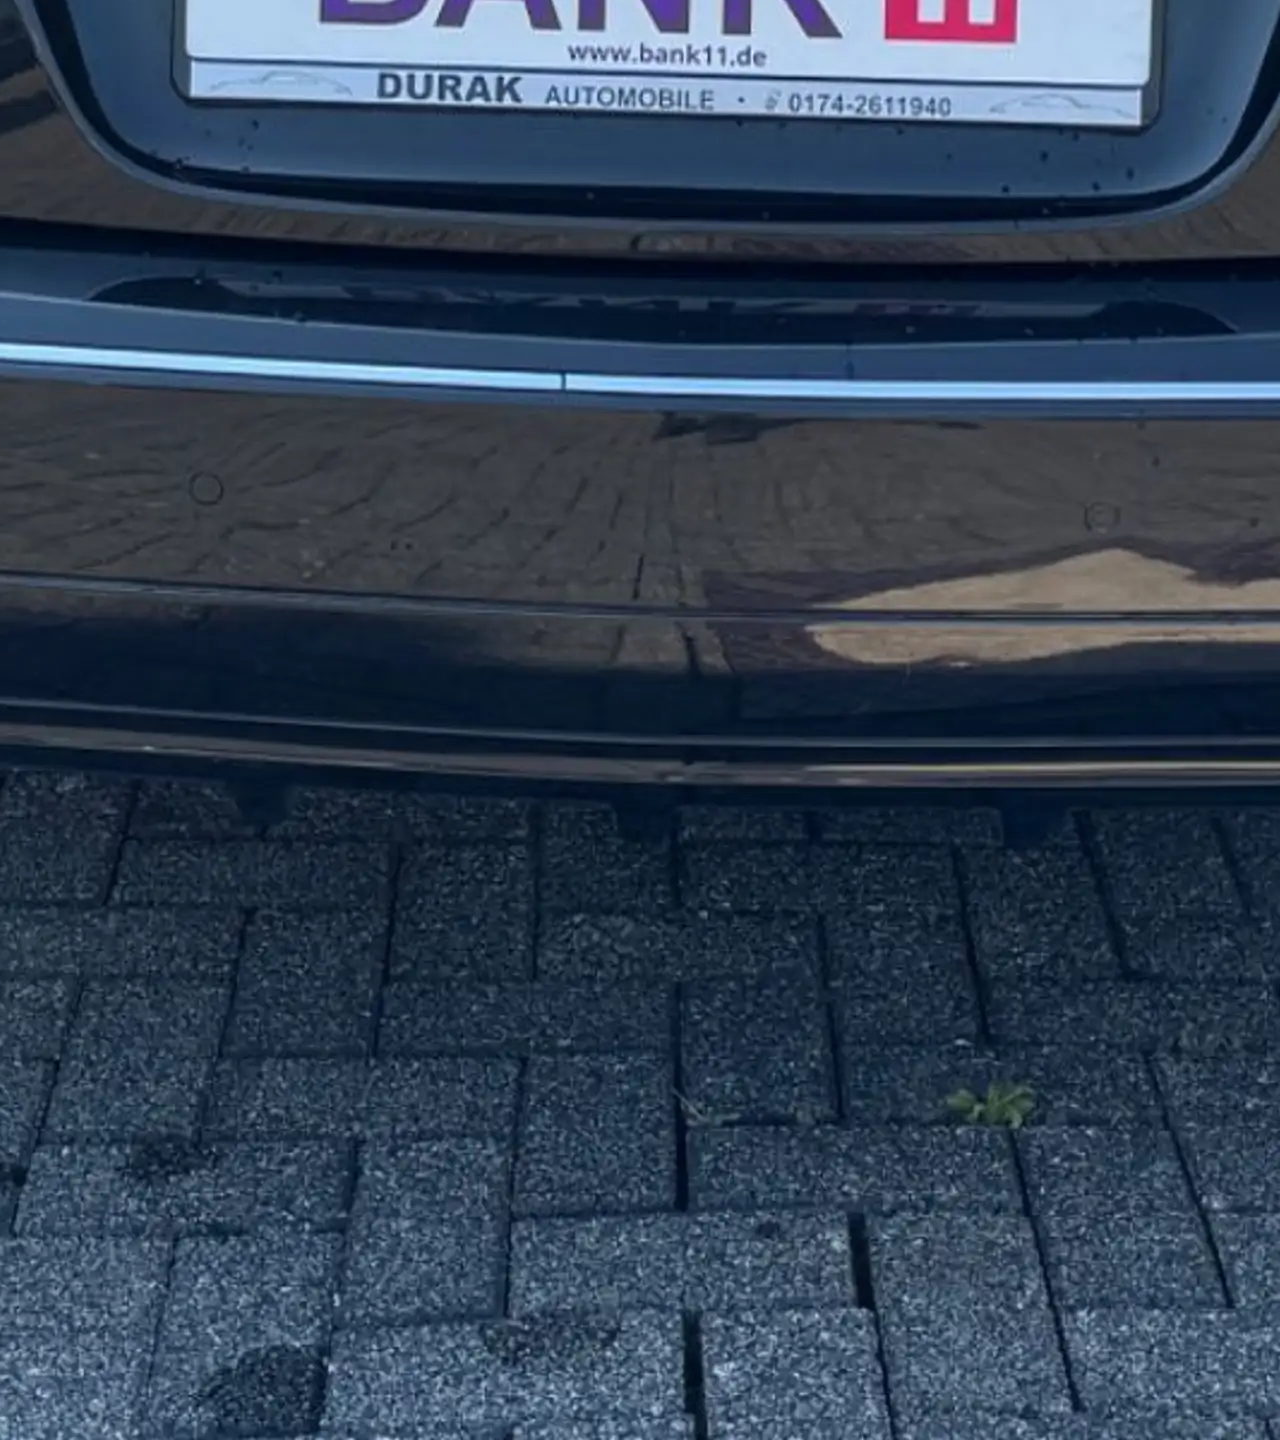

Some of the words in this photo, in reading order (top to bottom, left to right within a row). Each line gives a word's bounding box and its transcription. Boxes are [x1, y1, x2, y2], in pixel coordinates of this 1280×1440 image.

[567, 43, 768, 68] www.bank11.de
[376, 72, 524, 104] DURAK
[544, 85, 715, 111] AUTOMOBILE
[788, 93, 952, 117] 0174-2611940
